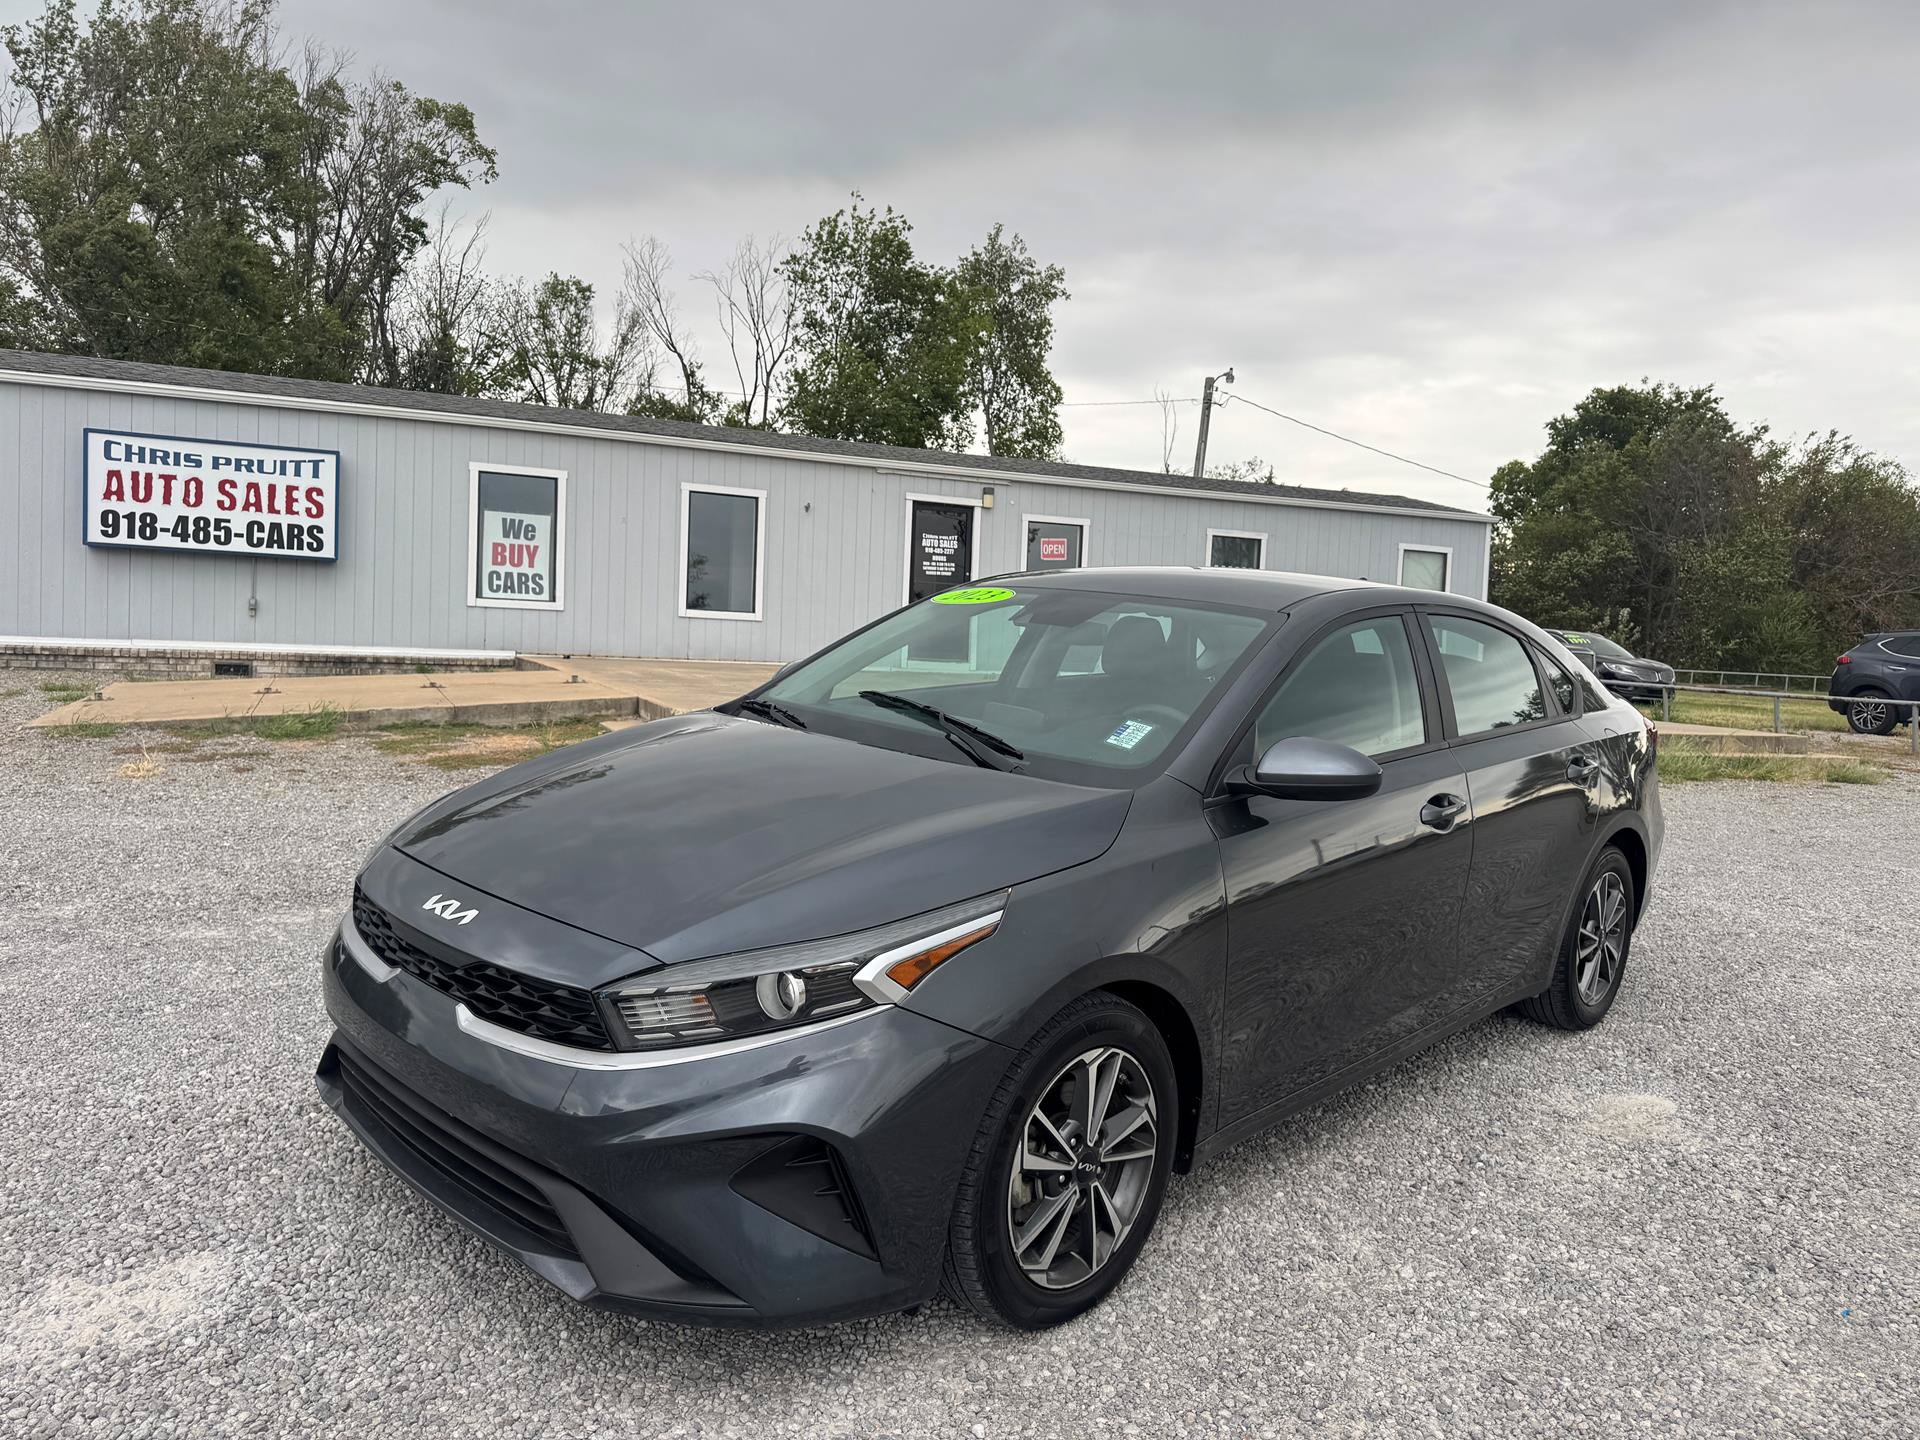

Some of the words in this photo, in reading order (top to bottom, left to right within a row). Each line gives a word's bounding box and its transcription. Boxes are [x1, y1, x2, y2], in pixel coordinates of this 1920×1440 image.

[103, 439, 203, 468] CHRIS
[211, 455, 326, 479] PRUITT
[102, 469, 204, 508] AUTO
[216, 478, 325, 519] SALES
[100, 508, 324, 552] 918-485-CARS
[501, 517, 537, 541] We
[491, 542, 539, 569] BUY
[921, 538, 939, 547] AUTO
[939, 540, 958, 549] SALES
[1043, 544, 1065, 555] OPEN
[487, 570, 544, 596] CARS
[422, 893, 480, 926] KIA
